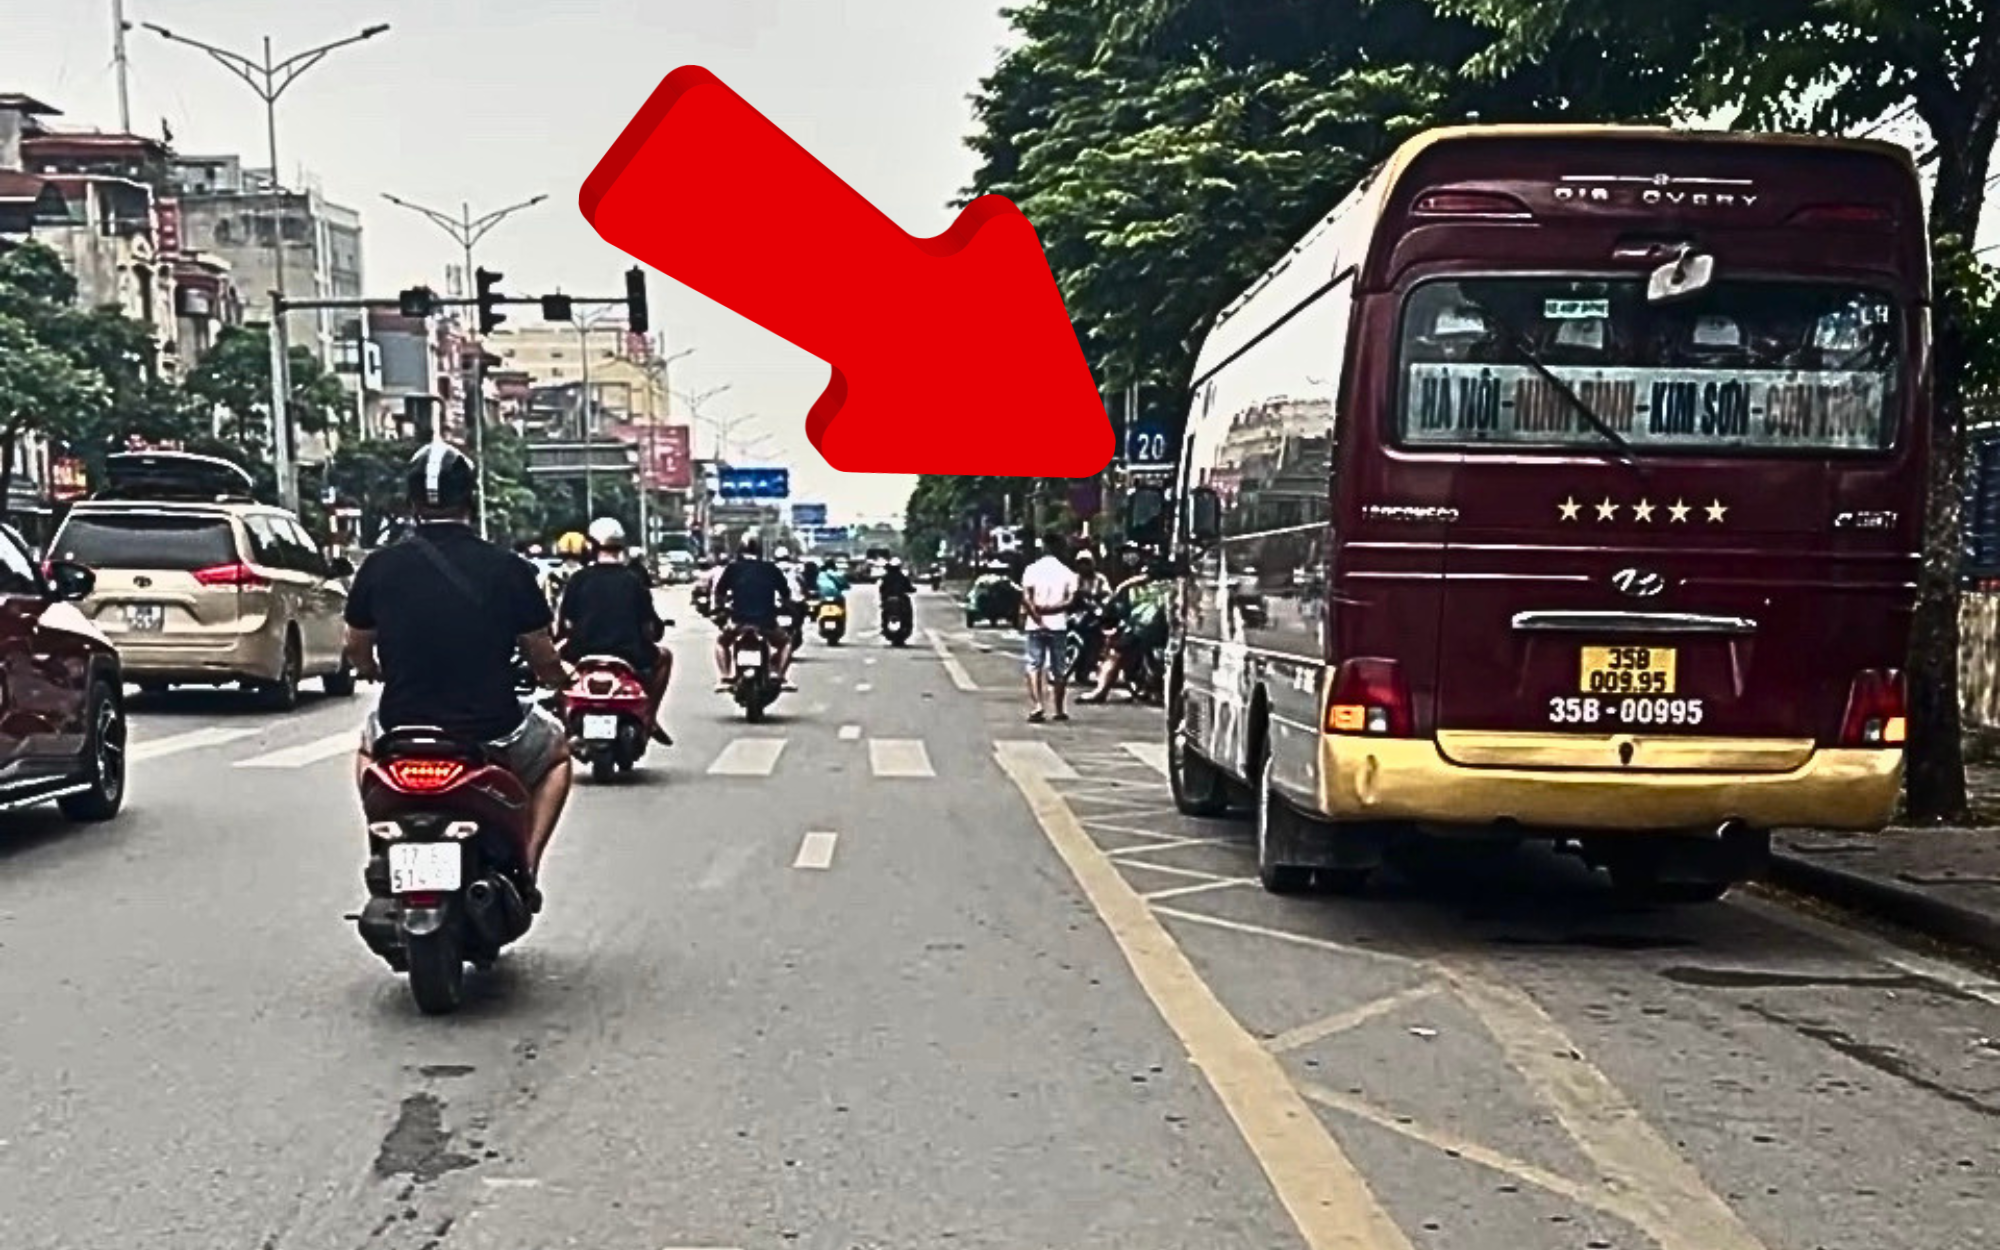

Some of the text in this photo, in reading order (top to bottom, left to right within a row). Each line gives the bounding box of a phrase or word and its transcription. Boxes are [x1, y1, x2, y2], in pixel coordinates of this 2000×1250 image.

[1650, 381, 1697, 434] KIM
[1137, 433, 1165, 460] 20
[1608, 649, 1650, 670] 35B
[1590, 670, 1667, 692] 009.95
